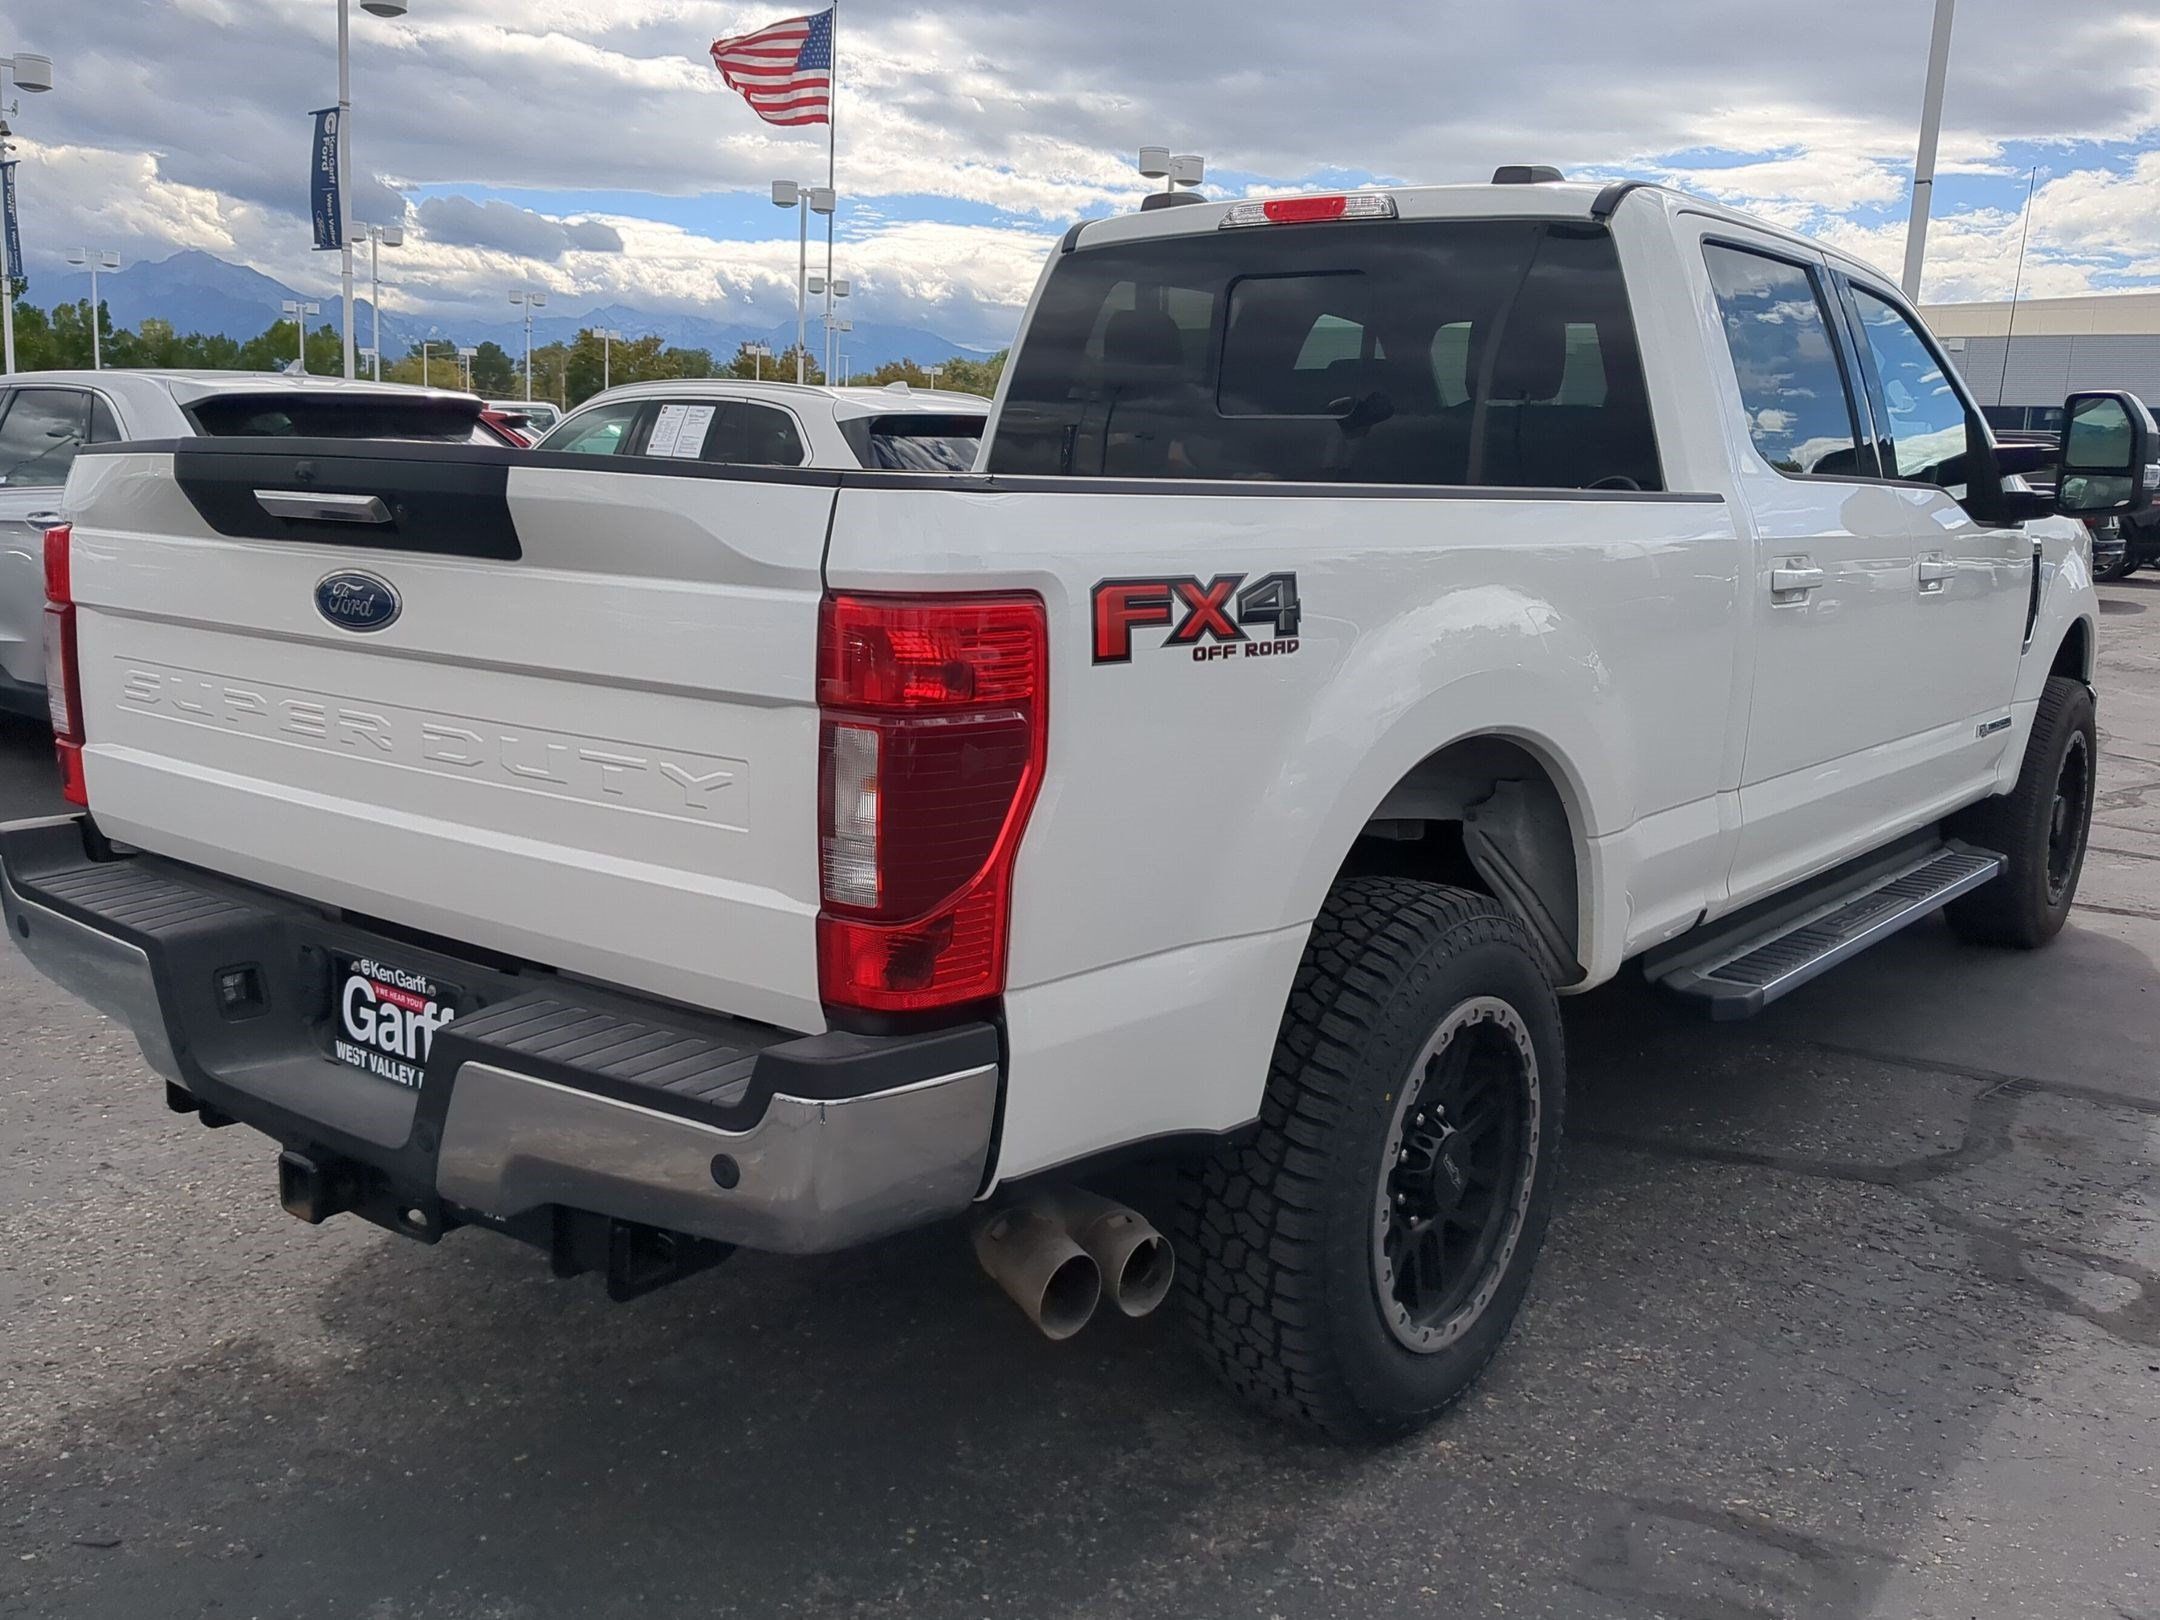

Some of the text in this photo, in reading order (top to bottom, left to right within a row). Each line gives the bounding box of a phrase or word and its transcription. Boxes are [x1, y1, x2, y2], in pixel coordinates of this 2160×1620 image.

[321, 136, 330, 171] Ford
[326, 193, 338, 247] West Valley
[328, 581, 375, 617] Ford
[1090, 571, 1302, 667] FX4
[1192, 639, 1300, 662] OFF ROAD
[124, 670, 734, 809] SUPER DUTY
[370, 961, 427, 993] Ken Garff
[380, 989, 419, 1007] WE HEAR YOU
[336, 1040, 367, 1068] WEST
[369, 1054, 415, 1086] VALLEY
